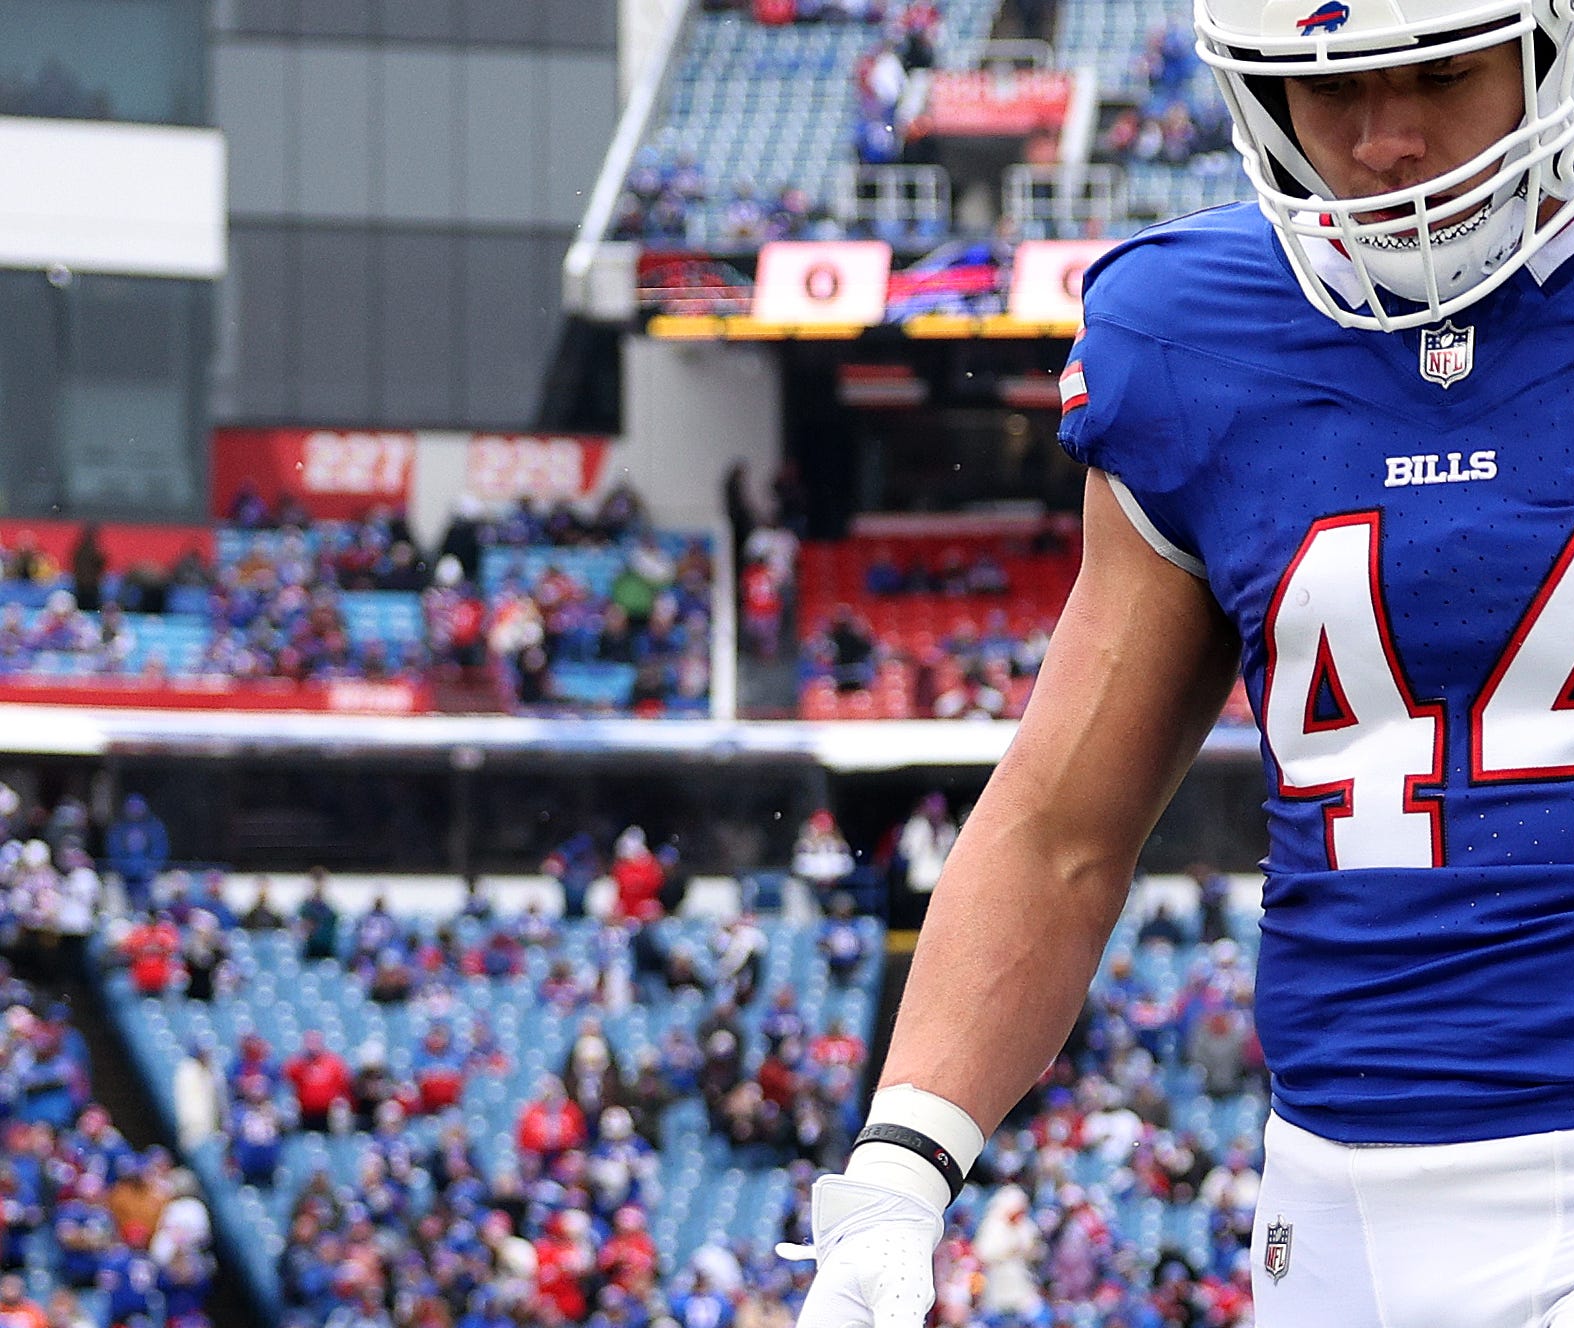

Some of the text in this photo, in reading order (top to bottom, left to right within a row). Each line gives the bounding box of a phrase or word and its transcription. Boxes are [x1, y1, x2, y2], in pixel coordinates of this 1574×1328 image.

[1429, 351, 1463, 375] NFL
[1384, 450, 1498, 488] BILLS
[1267, 1247, 1284, 1271] NFL
